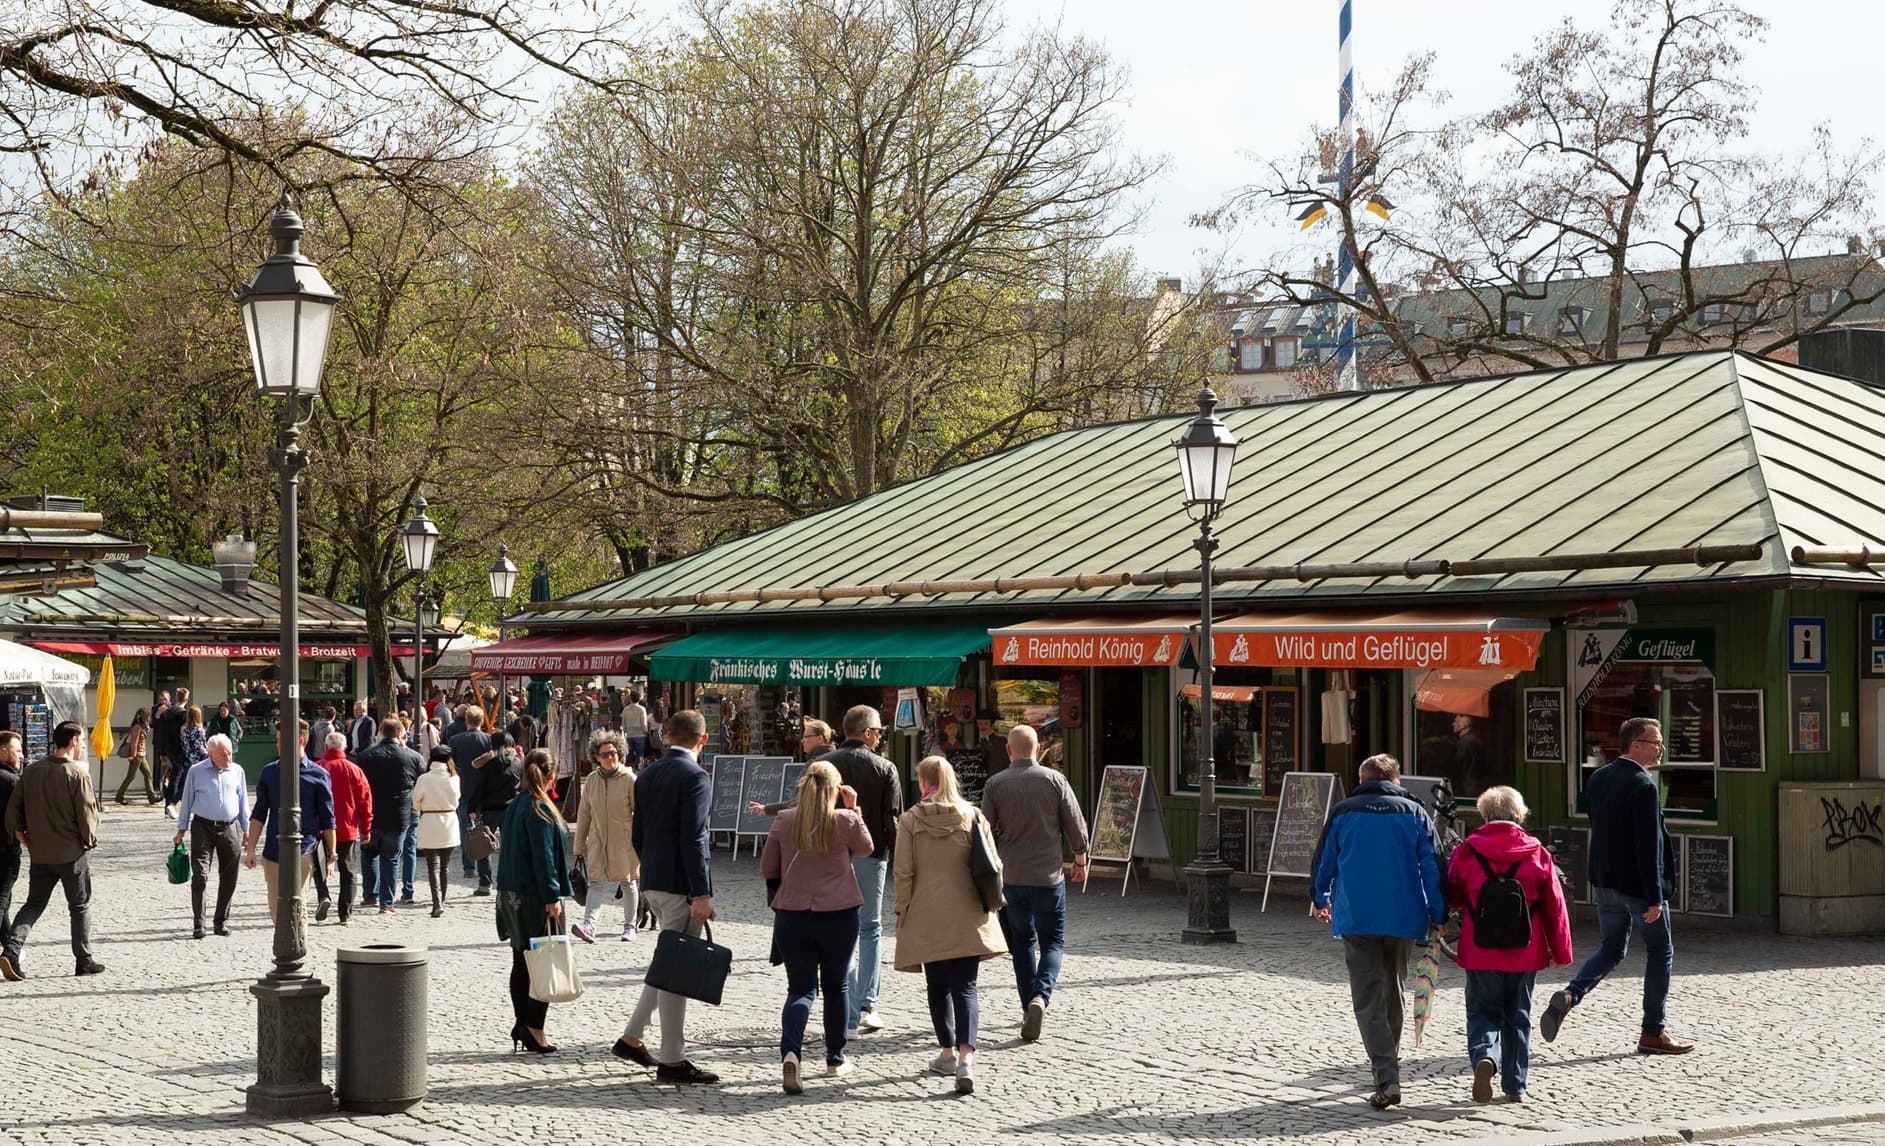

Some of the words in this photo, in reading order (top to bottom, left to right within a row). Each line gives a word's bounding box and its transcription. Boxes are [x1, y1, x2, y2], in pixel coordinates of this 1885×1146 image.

[117, 644, 160, 656] Imbiss
[172, 644, 230, 656] Getränke
[311, 646, 357, 657] Brotzeit
[1028, 637, 1094, 659] Reinhold
[1099, 637, 1144, 665] König
[1275, 636, 1315, 660] Wild
[1321, 636, 1356, 660] und
[1363, 636, 1448, 667] Geflügel
[1638, 639, 1696, 660] Geflügel
[710, 658, 778, 683] Fränkisches
[1576, 661, 1613, 710] REINHOLD
